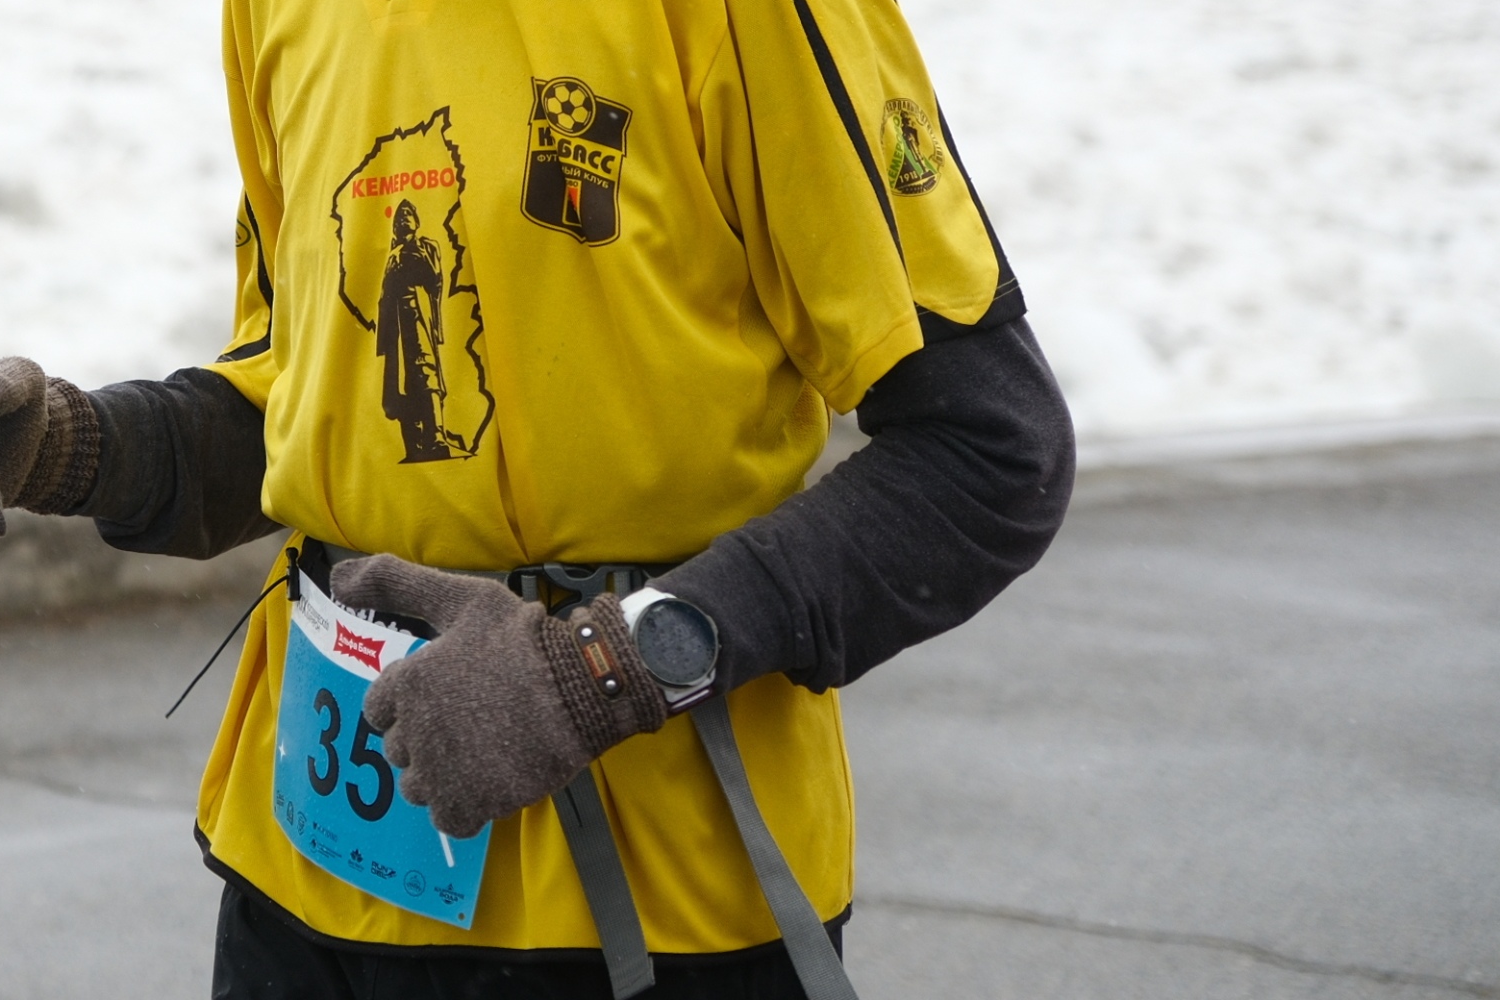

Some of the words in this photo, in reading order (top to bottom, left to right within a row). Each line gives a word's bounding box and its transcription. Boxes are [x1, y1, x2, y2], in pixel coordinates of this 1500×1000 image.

[352, 167, 456, 199] КЕМЕРОВО
[583, 173, 609, 190] КЛУБ
[358, 642, 377, 658] Банк
